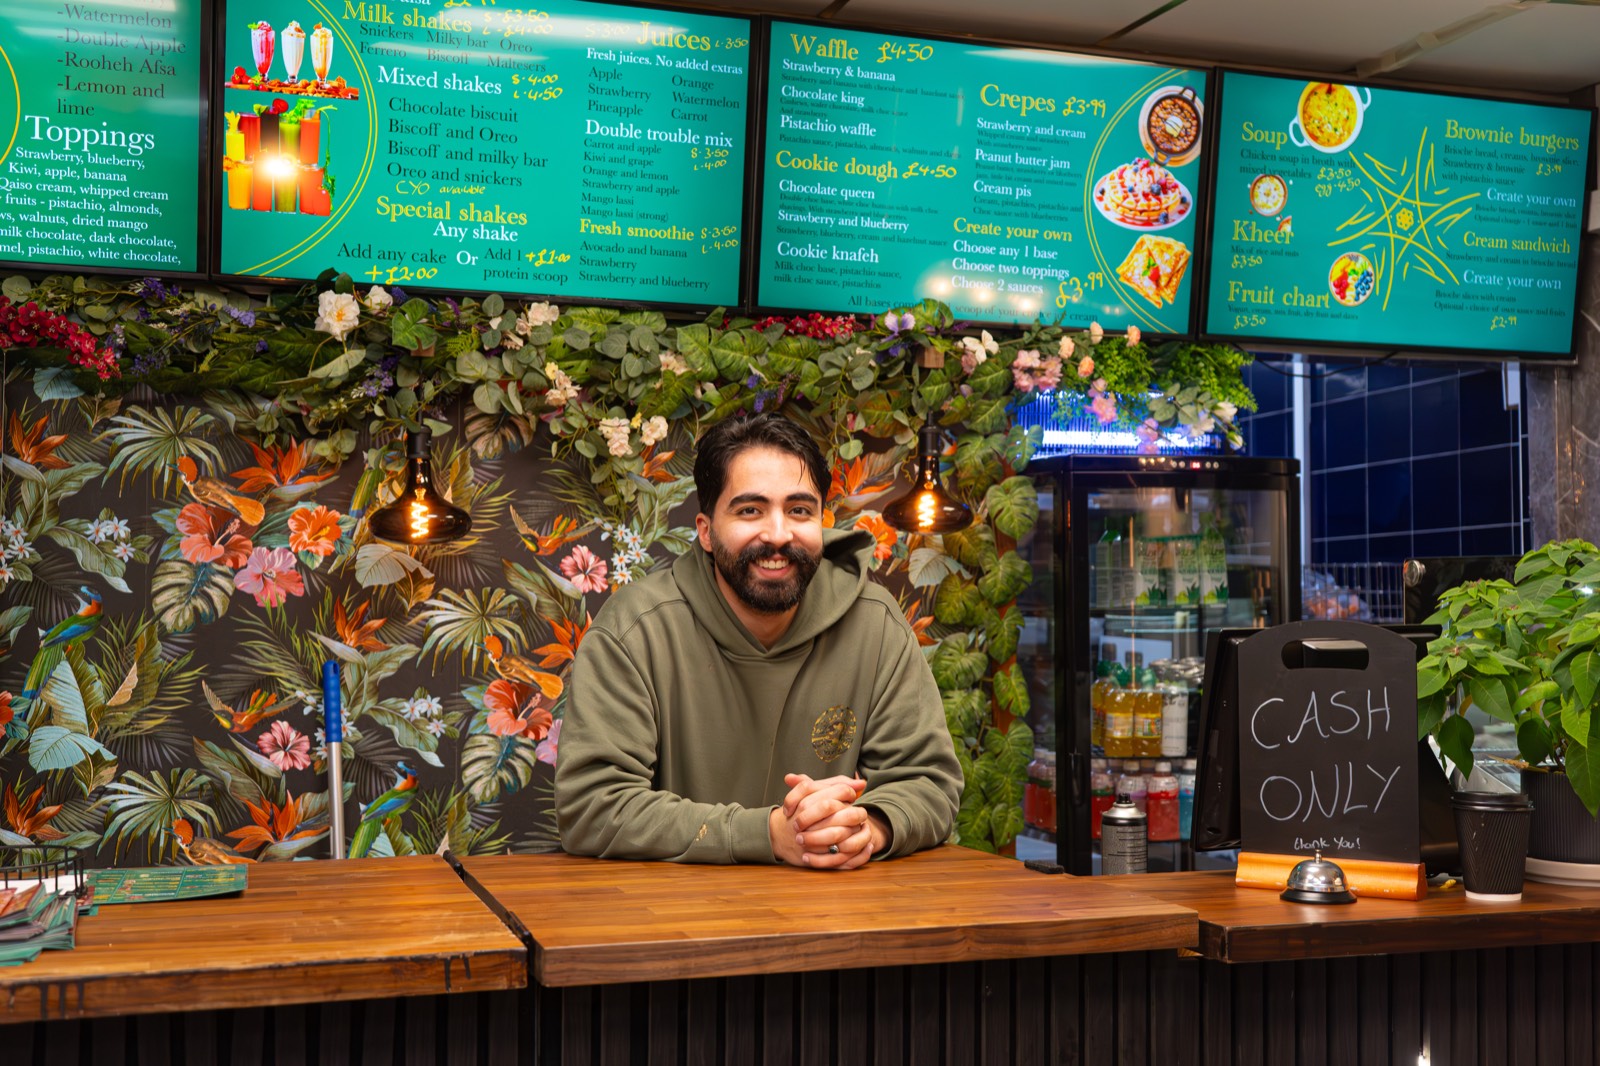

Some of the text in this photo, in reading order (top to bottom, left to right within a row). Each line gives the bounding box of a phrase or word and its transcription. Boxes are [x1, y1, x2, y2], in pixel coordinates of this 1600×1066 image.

[342, 1, 472, 33] Milk shakes
[135, 35, 186, 56] Apple
[360, 23, 532, 53] Snickers Milky bar Oreo
[636, 22, 711, 51] Juices
[790, 34, 858, 60] Waffle
[139, 58, 176, 76] Afsa
[360, 42, 546, 73] Ferrero Biscoff Maltesers
[586, 48, 742, 75] Fresh juices. No added extras
[378, 65, 502, 95] Mixed shakes
[588, 66, 714, 92] Apple Orange
[782, 59, 896, 82] Strawberry & banana
[132, 84, 165, 99] and
[588, 83, 740, 109] Strawberry Watermelon
[782, 85, 837, 103] Chocolate
[842, 92, 864, 107] king
[980, 84, 1056, 117] Crepes
[57, 98, 95, 116] lime
[388, 96, 518, 123] Chocolate biscuit
[588, 99, 708, 122] Pineapple Carrot
[24, 115, 155, 156] Toppings
[388, 118, 518, 144] Biscoff and Oreo
[586, 119, 733, 148] Double trouble mix
[780, 114, 876, 136] Pistachio waffle
[977, 117, 1086, 139] Strawberry and cream
[1242, 121, 1288, 150] Soup
[1445, 119, 1579, 155] Brownie burgers
[16, 146, 145, 170] Strawberry, blueberry,
[388, 140, 549, 169] Biscoff and milky bar
[975, 148, 1070, 170] Peanut butter jam
[8, 162, 127, 181] Kiwi, apple, banana
[387, 162, 522, 187] Oreo and snickers
[582, 165, 668, 181] Orange and lemon
[776, 150, 898, 183] Cookie dough
[36, 182, 169, 200] cream, whipped cream
[780, 180, 874, 201] Chocolate queen
[974, 180, 1032, 199] Cream pis
[1488, 187, 1576, 207] Create your own
[6, 193, 163, 217] fruits pistachio, almonds,
[376, 196, 528, 226] Special shakes
[19, 211, 68, 226] walnuts,
[72, 214, 104, 227] dried
[107, 219, 148, 232] mango
[433, 221, 518, 243] Any shake
[580, 218, 694, 241] Fresh smoothie
[778, 210, 909, 233] Strawberry and blueberry
[953, 217, 1002, 236] Create
[1006, 227, 1039, 239] your
[1044, 231, 1072, 242] own
[1232, 219, 1294, 245] Kheer
[26, 228, 176, 249] chocolate, dark chocolate,
[580, 240, 687, 258] Avocado and banana
[953, 240, 1058, 260] Choose any base
[1464, 231, 1570, 254] Cream sandwich
[28, 244, 84, 259] pistachio,
[88, 248, 120, 259] white
[123, 250, 181, 265] chocolate,
[337, 243, 446, 268] Add any cake
[456, 250, 478, 266] Or
[484, 248, 511, 261] Add
[777, 241, 878, 263] Cookie knafeh
[580, 256, 636, 272] Strawberry
[952, 258, 1070, 281] Choose two toppings
[484, 267, 568, 286] protein scoop
[579, 271, 710, 292] Strawberry and blueberry
[952, 275, 1043, 294] Choose sauces
[1464, 269, 1561, 290] Create your own
[1228, 280, 1330, 308] Fruit chart
[1252, 686, 1390, 749] CASH
[1260, 762, 1400, 822] ONLY
